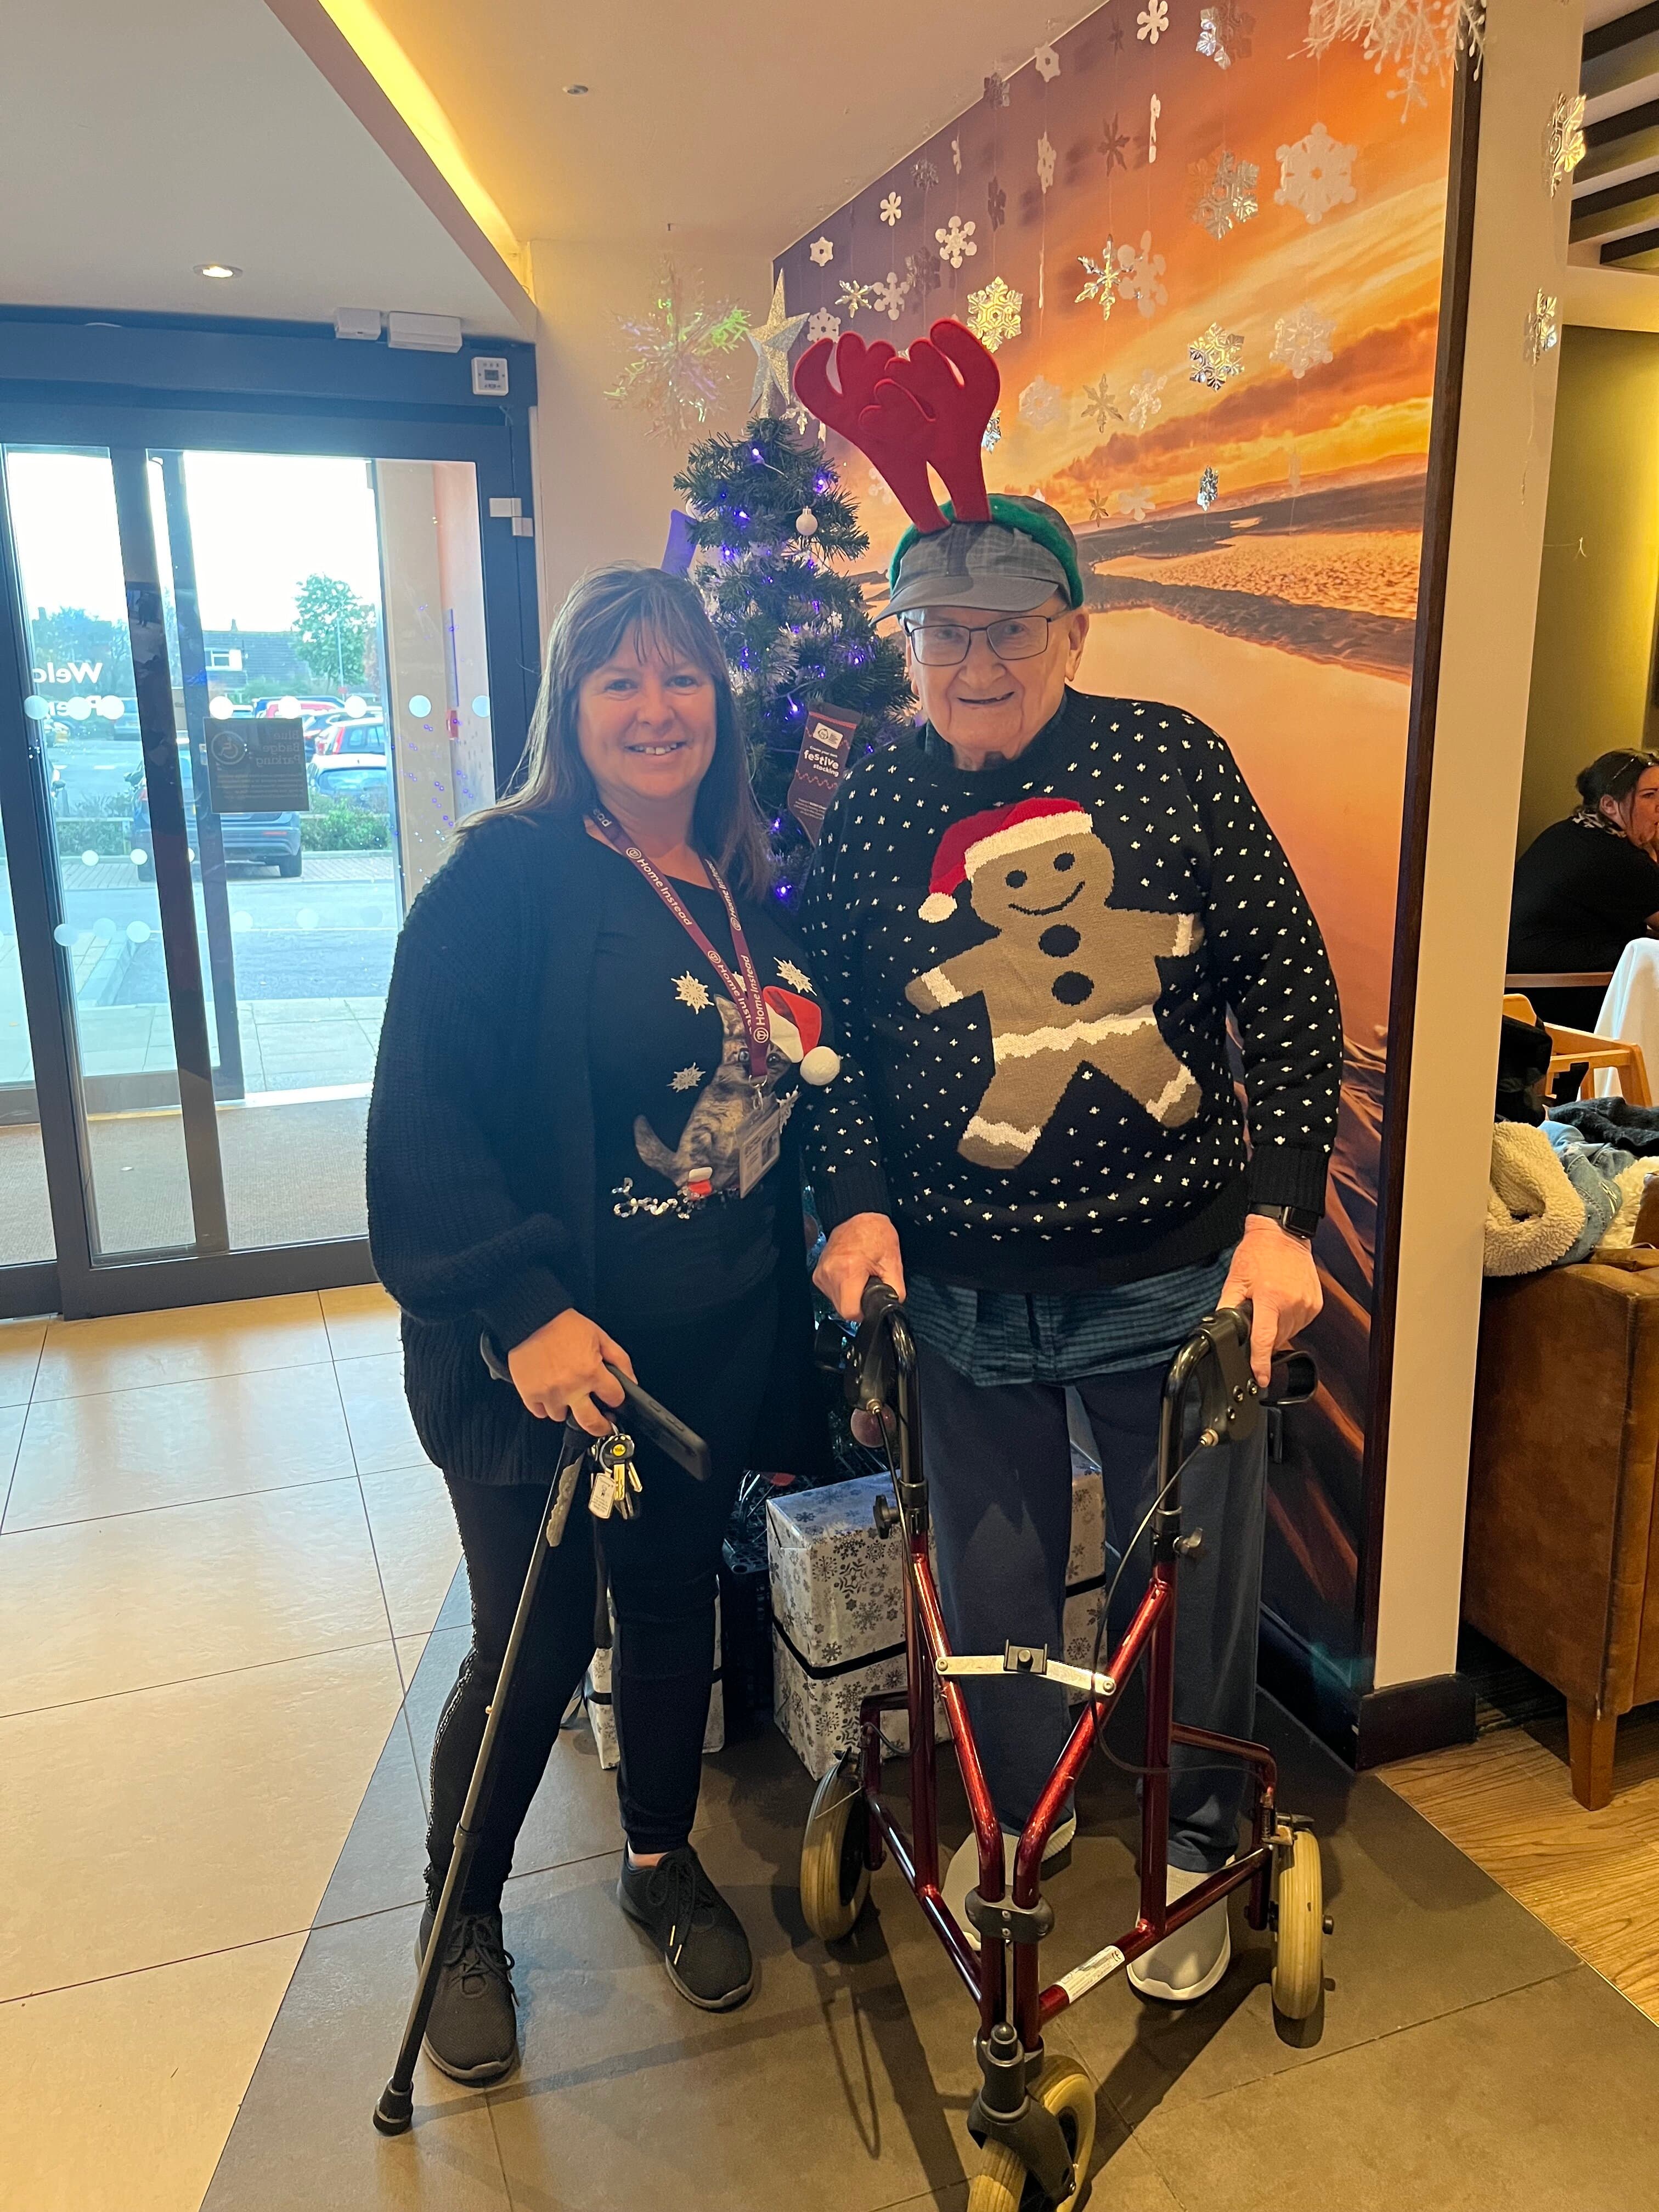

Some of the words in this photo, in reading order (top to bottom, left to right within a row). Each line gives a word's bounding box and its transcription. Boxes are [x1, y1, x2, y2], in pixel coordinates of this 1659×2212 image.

[804, 749, 839, 769] festive
[813, 764, 839, 777] stocking
[636, 859, 663, 887] Home
[660, 887, 692, 926] Instead
[722, 889, 737, 918] Home
[717, 964, 741, 997] Home
[741, 955, 759, 993] Instead
[754, 994, 765, 1025] Home
